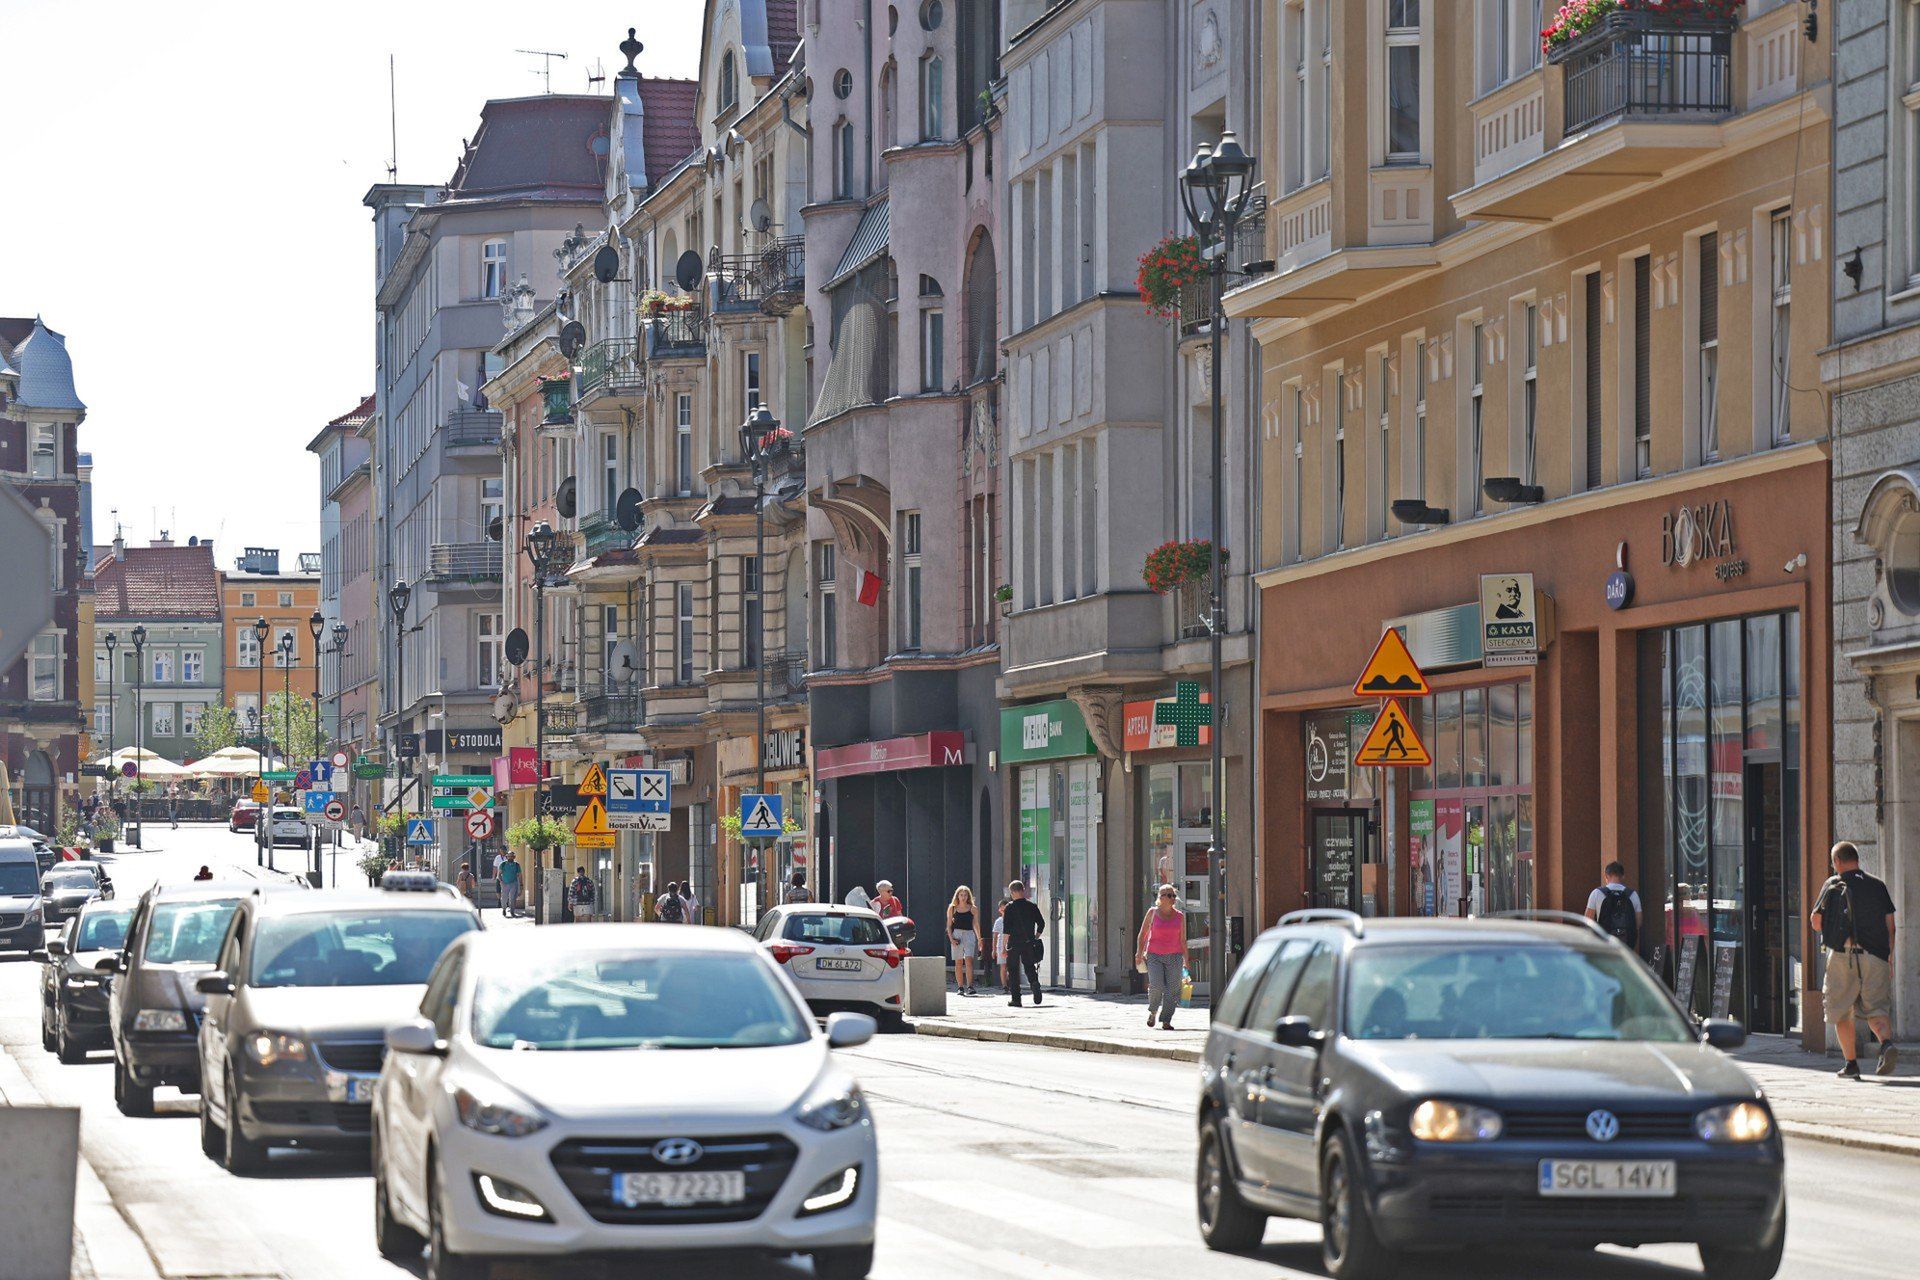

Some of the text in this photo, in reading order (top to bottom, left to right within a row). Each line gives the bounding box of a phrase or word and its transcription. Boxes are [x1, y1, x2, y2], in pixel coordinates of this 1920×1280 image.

[1662, 499, 1734, 569] BOSKA
[1714, 560, 1745, 583] express
[1501, 625, 1531, 635] KASY
[1488, 637, 1533, 647] STEFCZYKA
[1127, 715, 1149, 736] APTEKA
[460, 734, 501, 747] STODOLA
[630, 818, 656, 829] SILVIA
[1328, 862, 1351, 872] soboty
[1555, 1162, 1671, 1189] SGL 14VY
